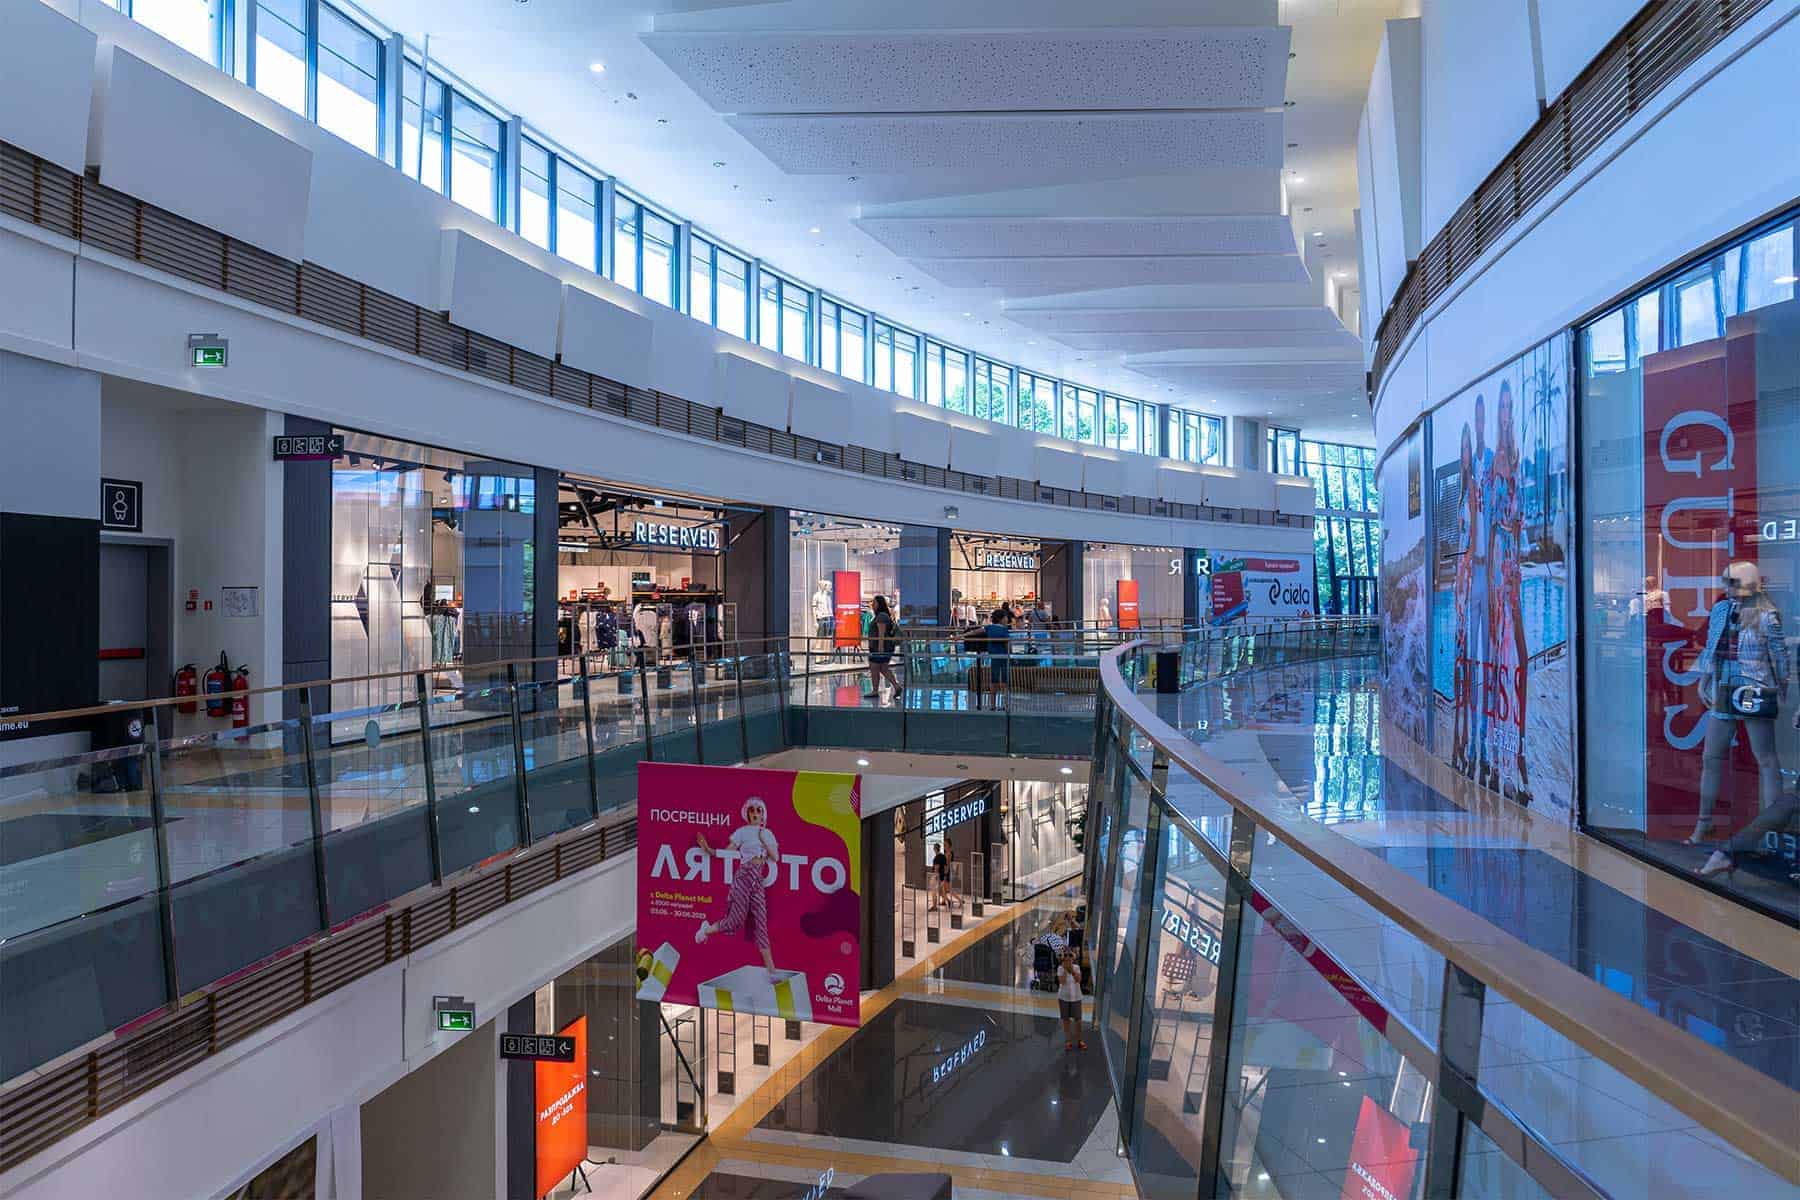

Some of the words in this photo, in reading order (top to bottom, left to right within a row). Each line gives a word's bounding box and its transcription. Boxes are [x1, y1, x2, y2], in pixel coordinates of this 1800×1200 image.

[635, 521, 719, 549] RESERVED
[986, 553, 1035, 569] RESERVED
[1197, 558, 1210, 575] R
[1282, 583, 1311, 605] ciela
[650, 808, 730, 827] ПОСРЕЩНИ
[933, 799, 985, 833] RESERVED
[816, 994, 832, 1003] Delta
[832, 996, 853, 1006] Planet
[827, 1004, 842, 1013] Mall
